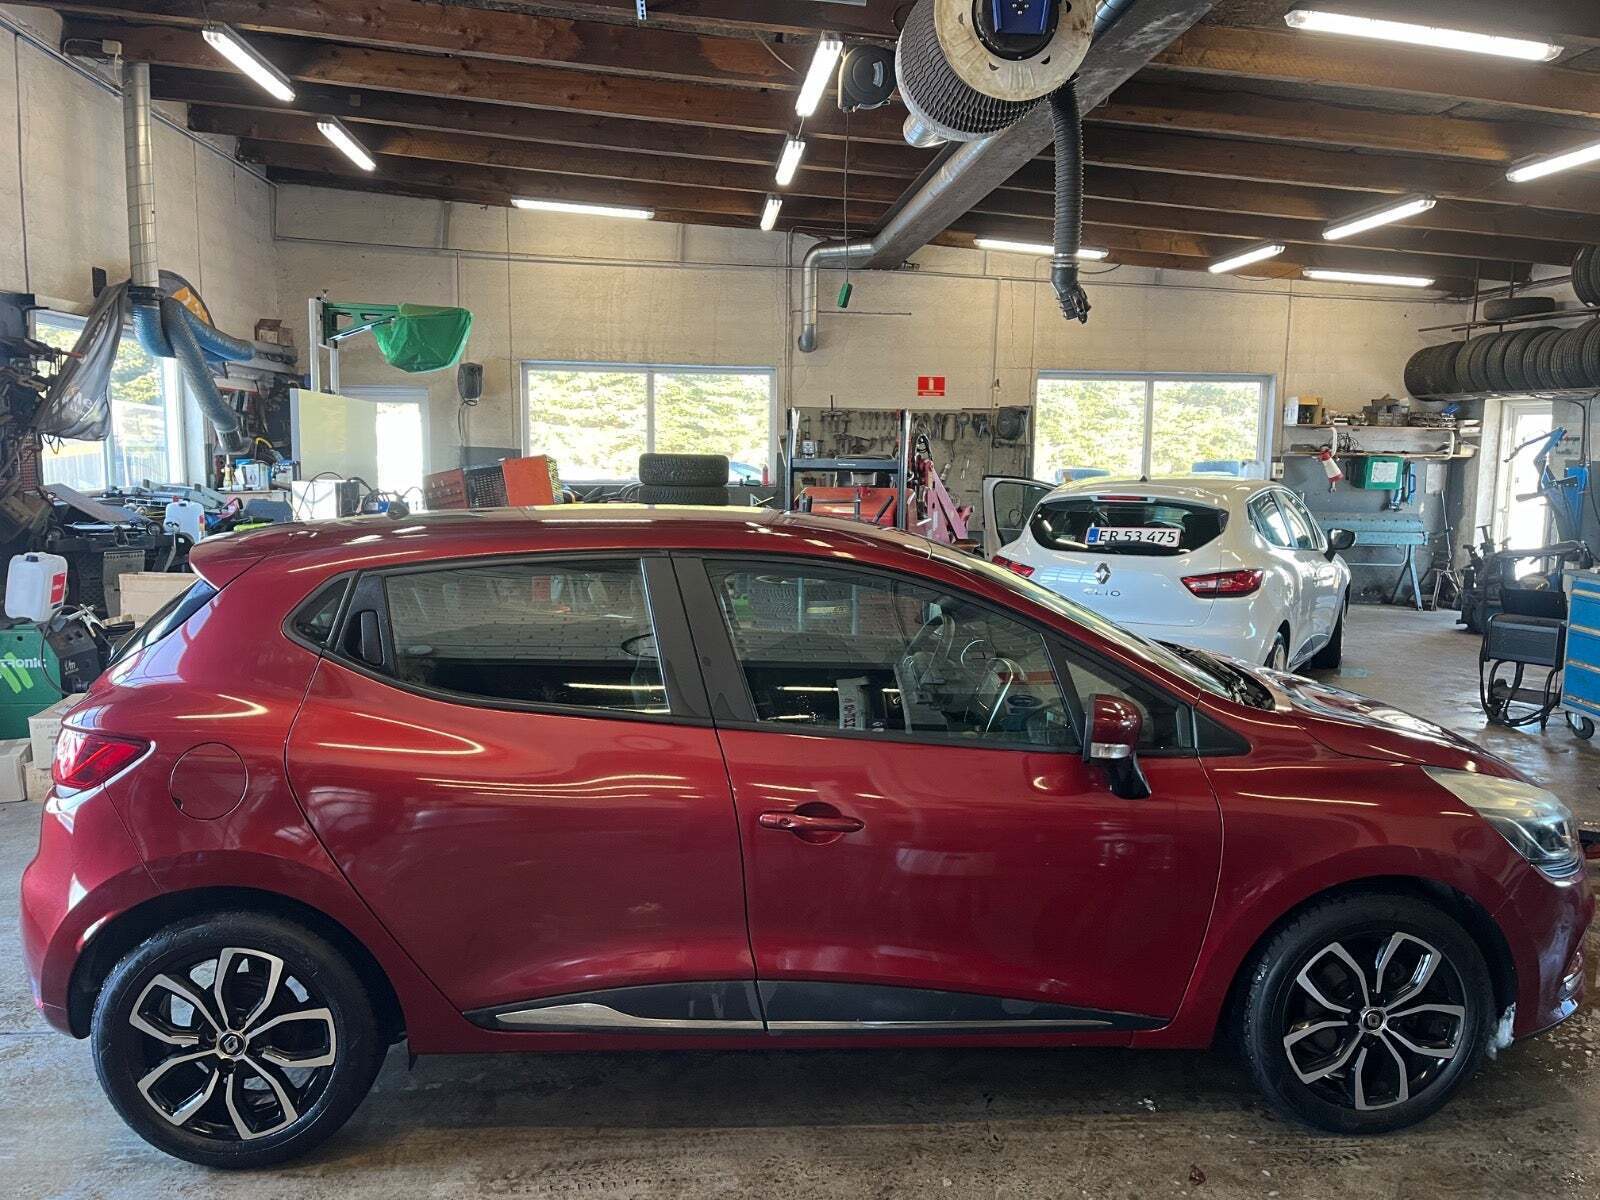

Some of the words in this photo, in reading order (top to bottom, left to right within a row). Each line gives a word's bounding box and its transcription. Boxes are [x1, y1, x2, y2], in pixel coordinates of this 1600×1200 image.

[1099, 530, 1118, 541] ER
[1124, 530, 1142, 541] 53
[1147, 530, 1177, 543] 475
